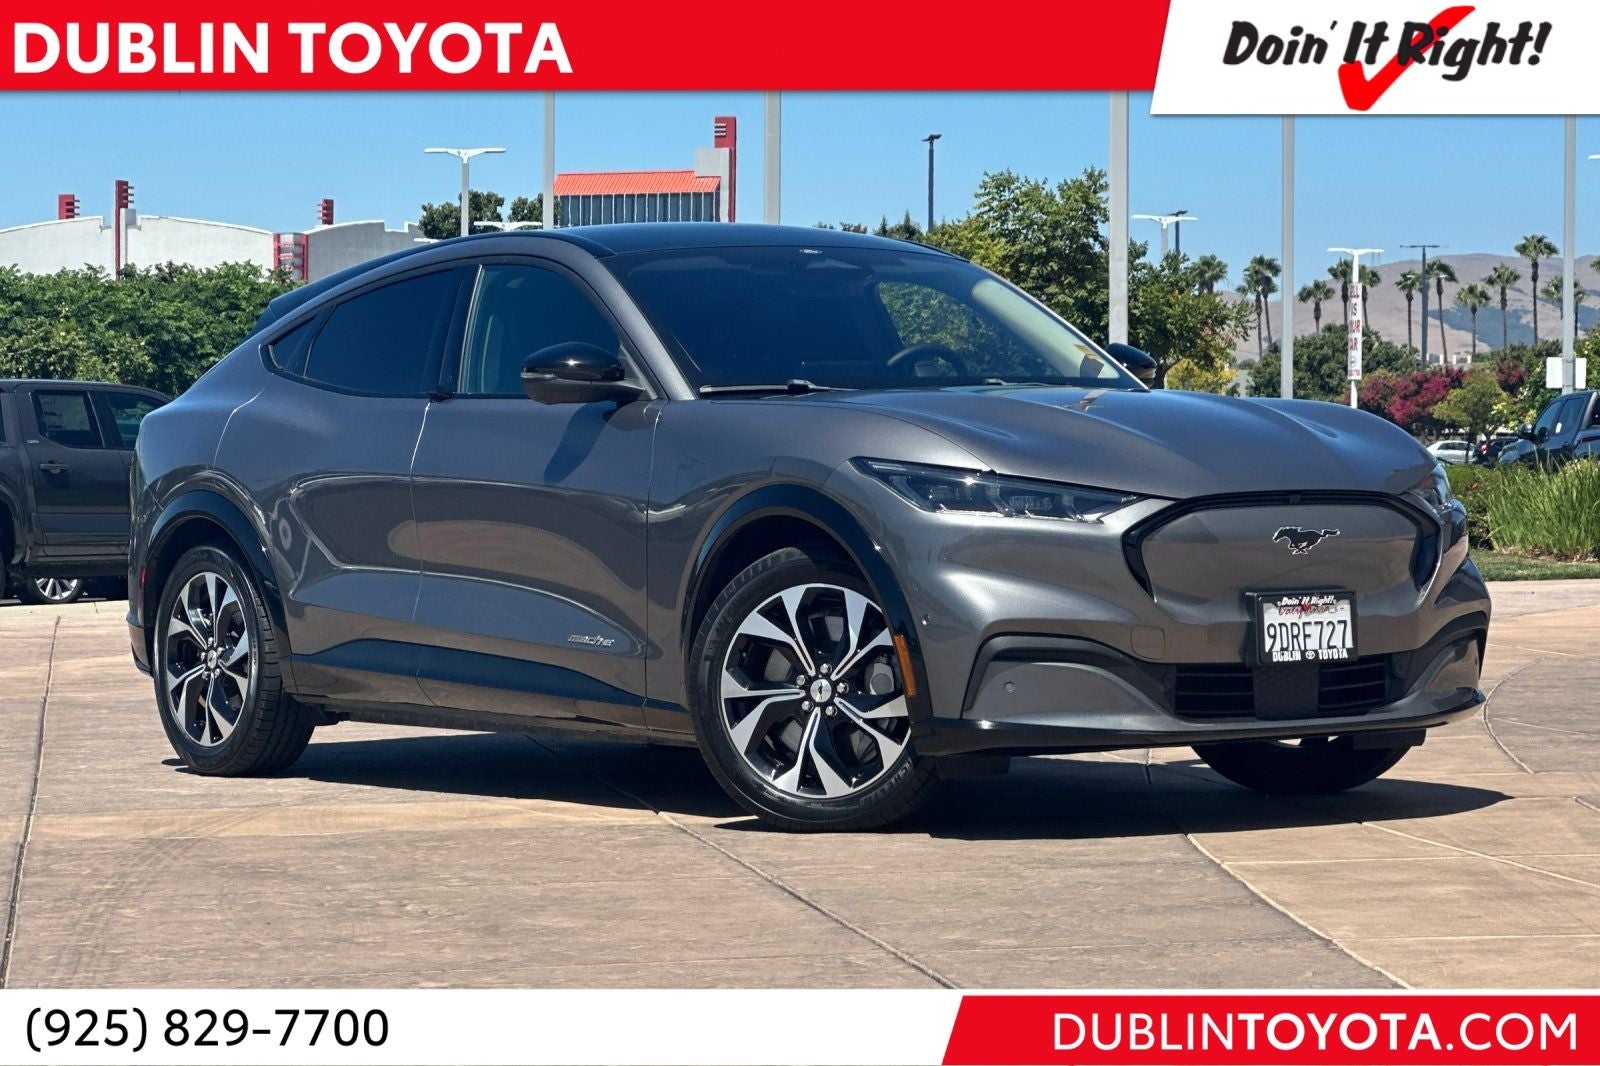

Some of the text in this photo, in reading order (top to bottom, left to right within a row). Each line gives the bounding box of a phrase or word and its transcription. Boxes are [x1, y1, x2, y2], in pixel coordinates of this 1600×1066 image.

[1266, 620, 1348, 652] 9DRF727
[1272, 648, 1349, 662] DUBLIN TOYOTA
